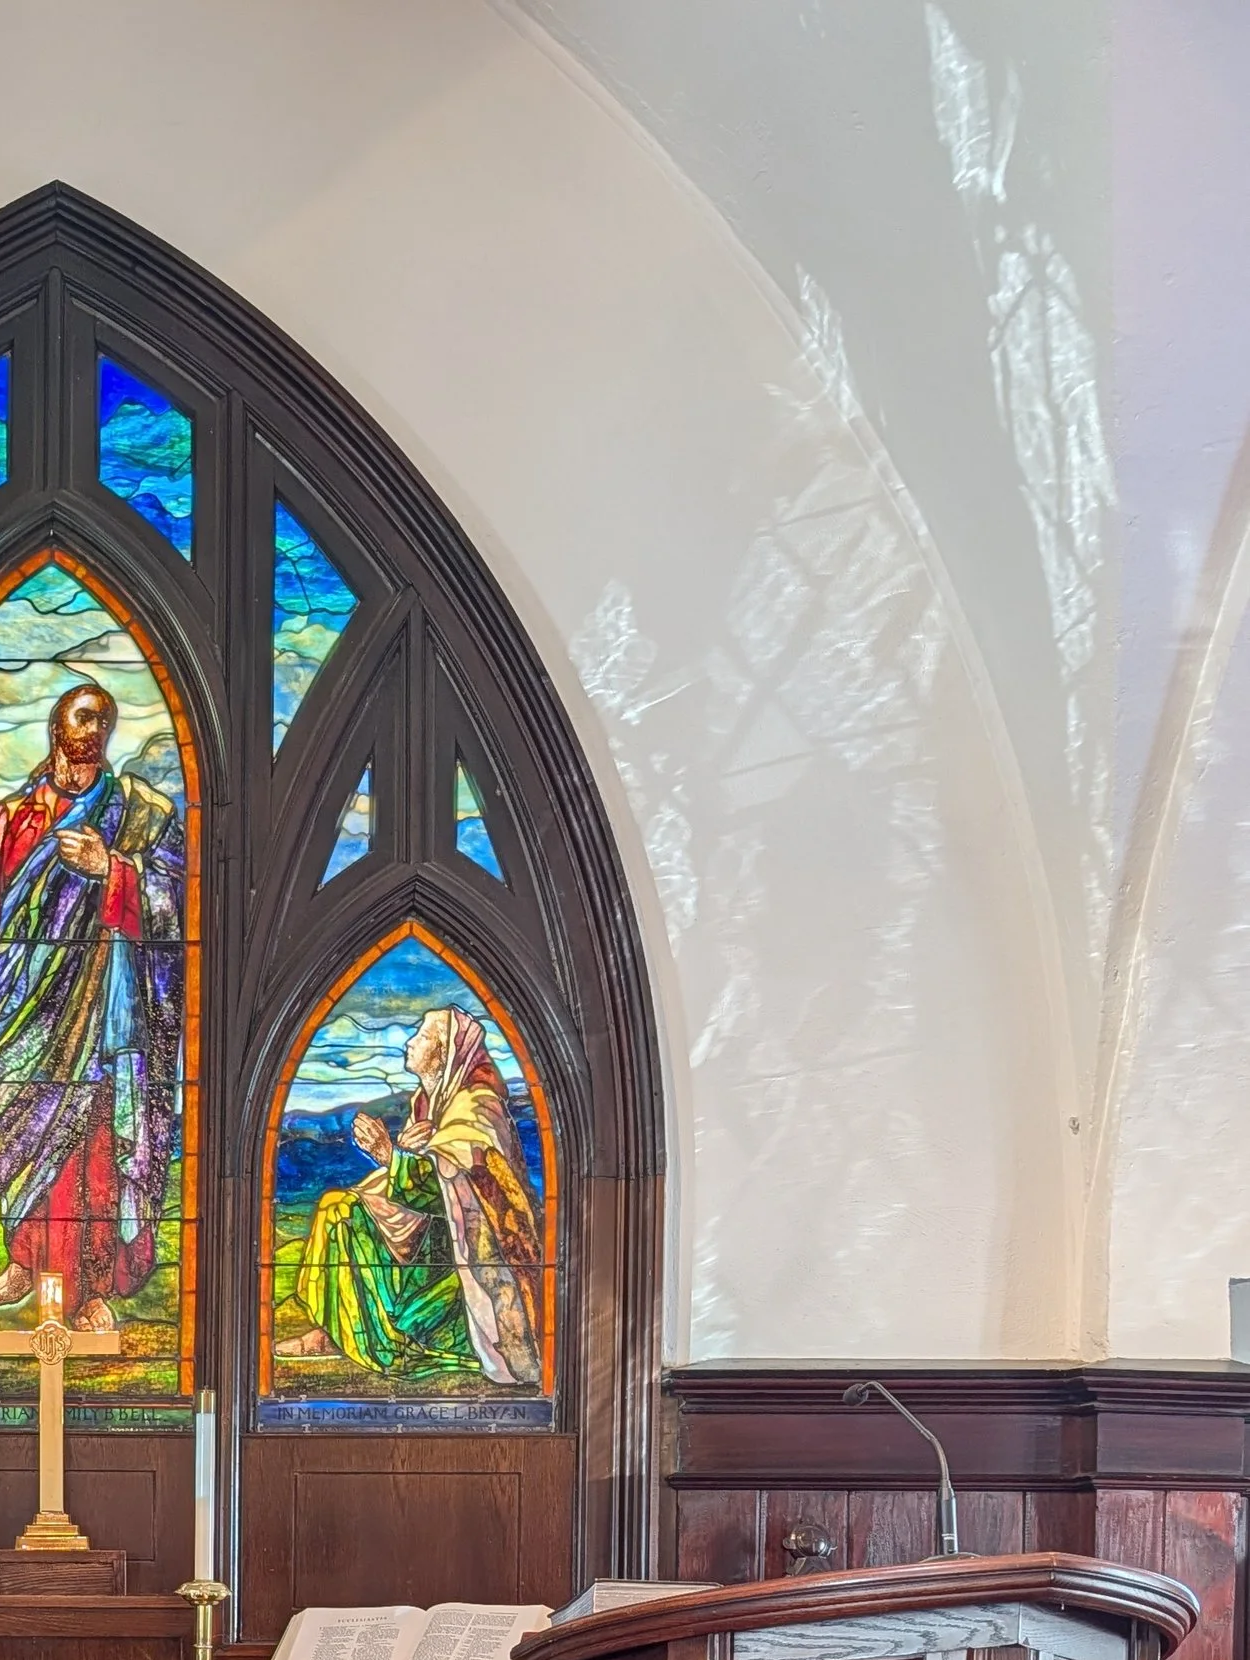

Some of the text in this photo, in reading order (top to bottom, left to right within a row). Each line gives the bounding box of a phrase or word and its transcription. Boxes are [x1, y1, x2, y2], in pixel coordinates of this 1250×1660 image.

[278, 1407, 294, 1420] IN
[298, 1407, 387, 1421] MEMORIAM
[394, 1406, 449, 1421] GRACE
